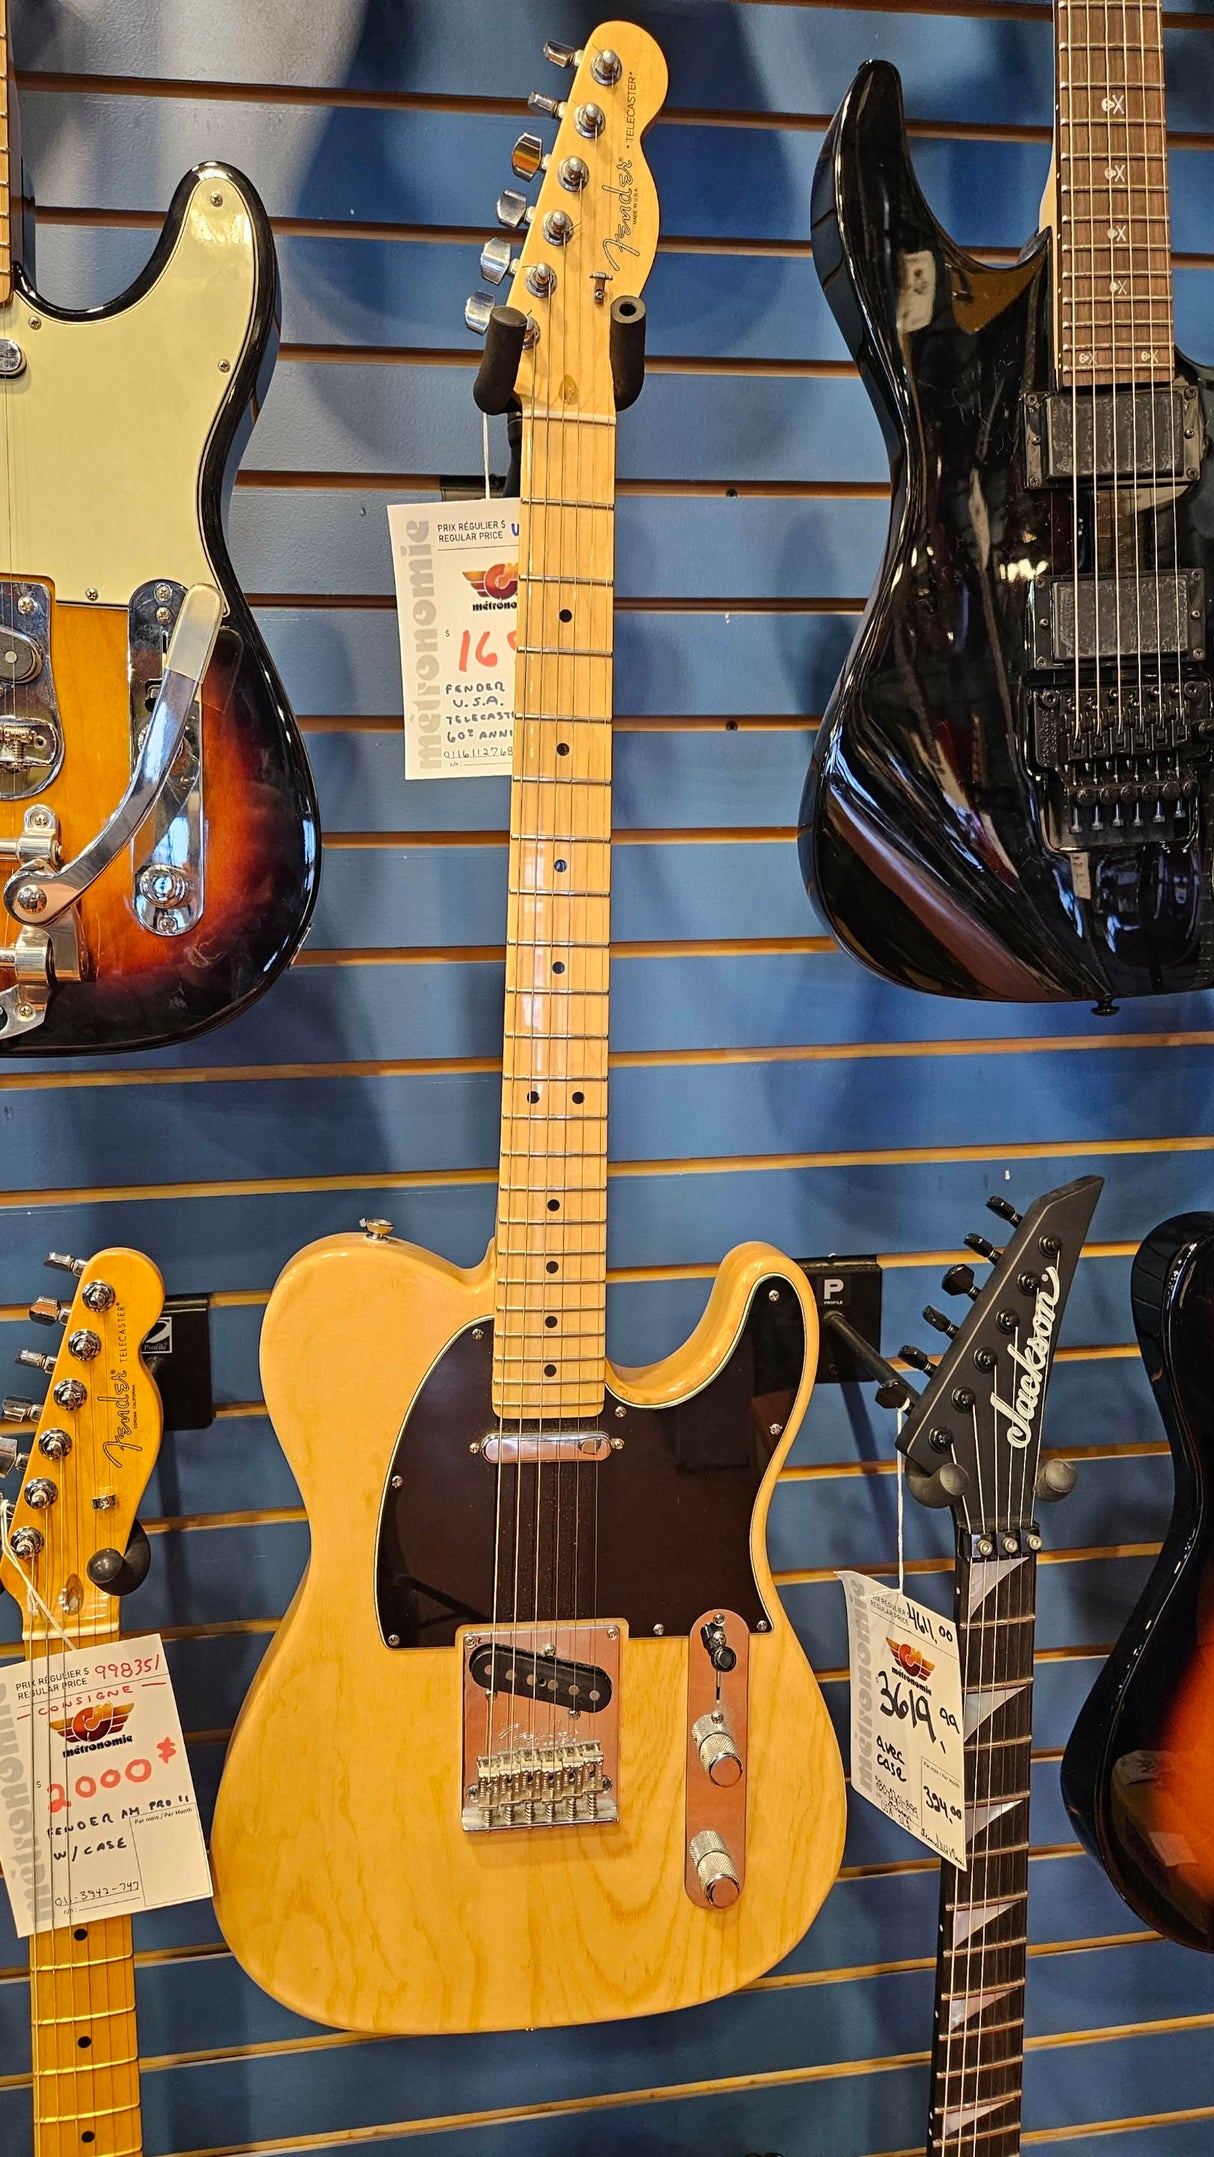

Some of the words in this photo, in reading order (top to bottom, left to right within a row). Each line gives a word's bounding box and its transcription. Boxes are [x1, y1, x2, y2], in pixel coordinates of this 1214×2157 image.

[624, 76, 638, 143] TELECASTER
[437, 523, 456, 532] PRIX
[458, 520, 498, 531] RÉGULIER
[500, 519, 506, 529] $
[438, 532, 477, 543] REGULAR
[479, 531, 503, 540] PRICE
[399, 519, 442, 770] métronomie
[445, 629, 450, 638] $
[445, 681, 506, 695] FENDER
[452, 696, 504, 708] U.S.A.
[823, 1278, 844, 1300] P
[118, 1306, 128, 1363] TELECASTER
[990, 1266, 1060, 1449] Jackson
[15, 1680, 36, 1691] PRIX
[38, 1668, 82, 1685] RÉGULIER
[83, 1667, 90, 1675] $
[94, 1654, 160, 1680] 998351
[17, 1684, 60, 1700] REGULAR
[62, 1677, 88, 1689] PRICE
[38, 1685, 133, 1716] CONSIGNE
[62, 1734, 133, 1758] métronomie
[876, 1734, 906, 1765] avec
[877, 1753, 907, 1782] case
[46, 1812, 114, 1838] FENDER
[121, 1806, 140, 1819] AM
[148, 1799, 172, 1811] PRO
[134, 1817, 144, 1825] Par
[145, 1814, 159, 1822] mois
[164, 1810, 174, 1818] Per
[175, 1807, 193, 1816] Month
